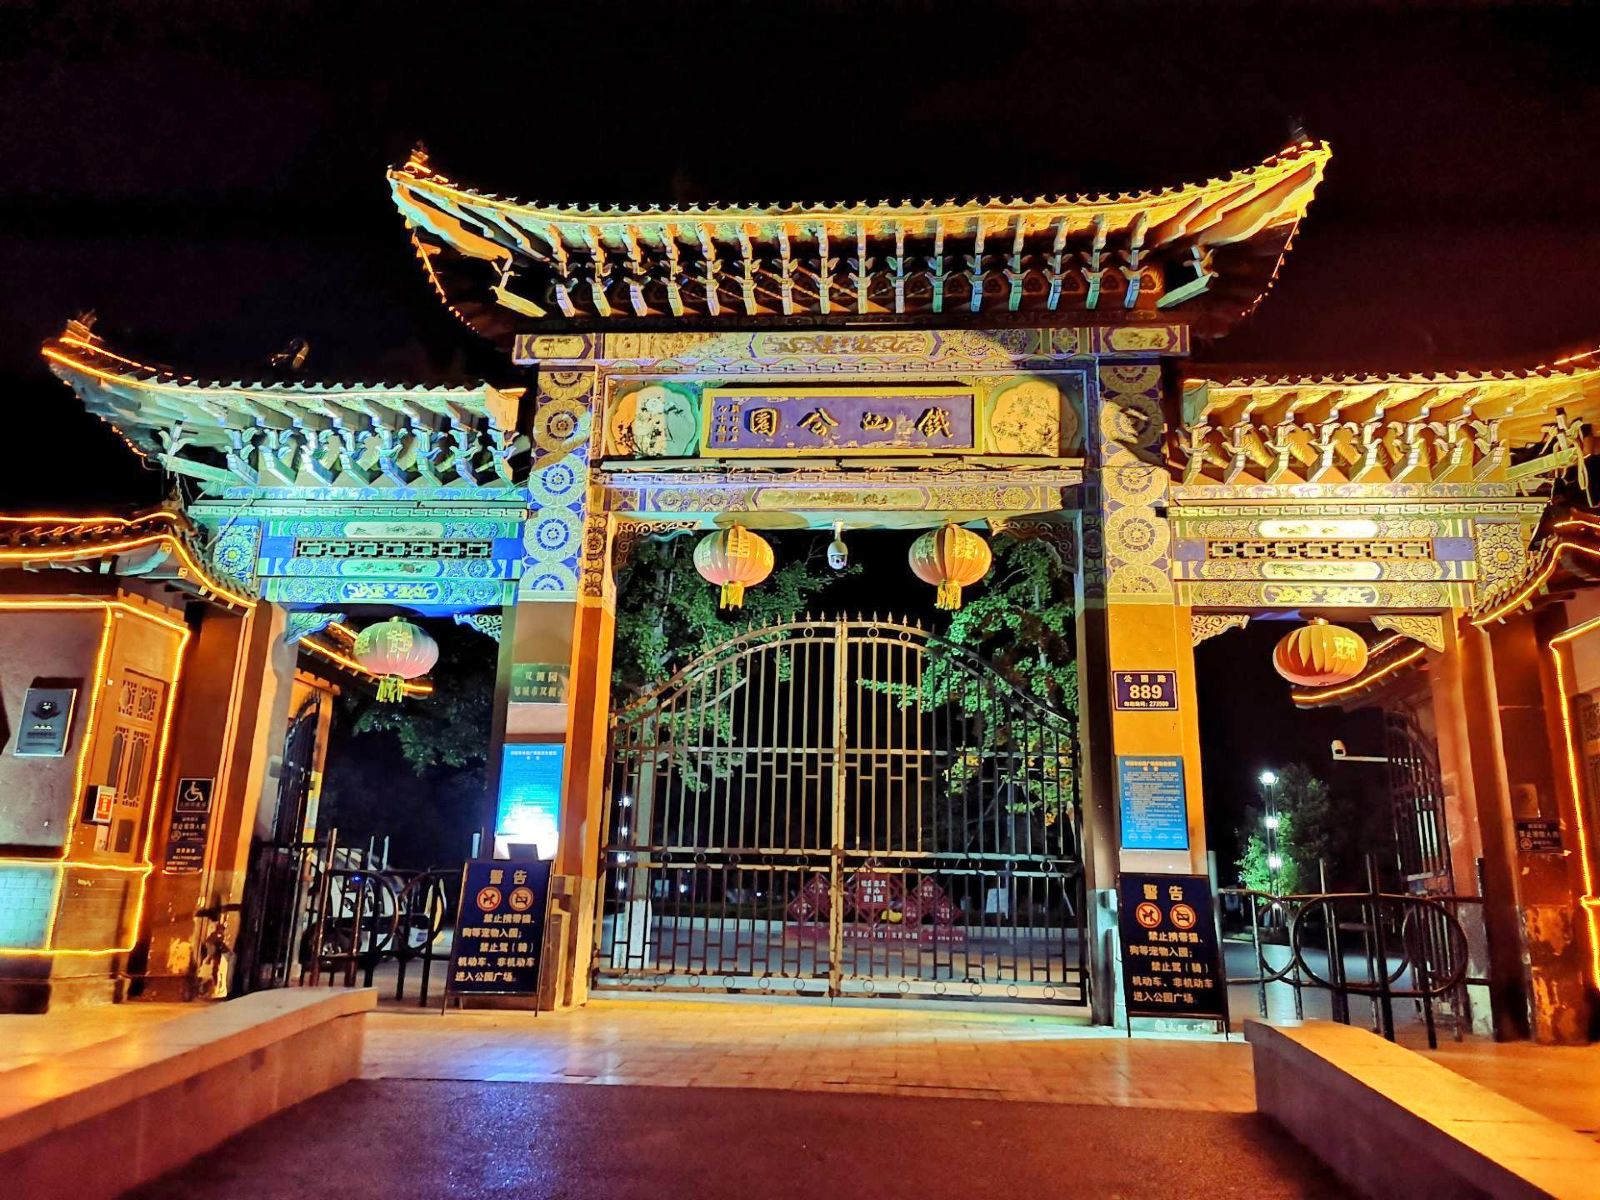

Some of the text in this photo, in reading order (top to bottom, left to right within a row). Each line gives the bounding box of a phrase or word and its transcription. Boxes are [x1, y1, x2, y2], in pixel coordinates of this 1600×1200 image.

[1129, 684, 1163, 699] 889
[489, 869, 527, 885] 警告
[1143, 884, 1183, 901] 警告
